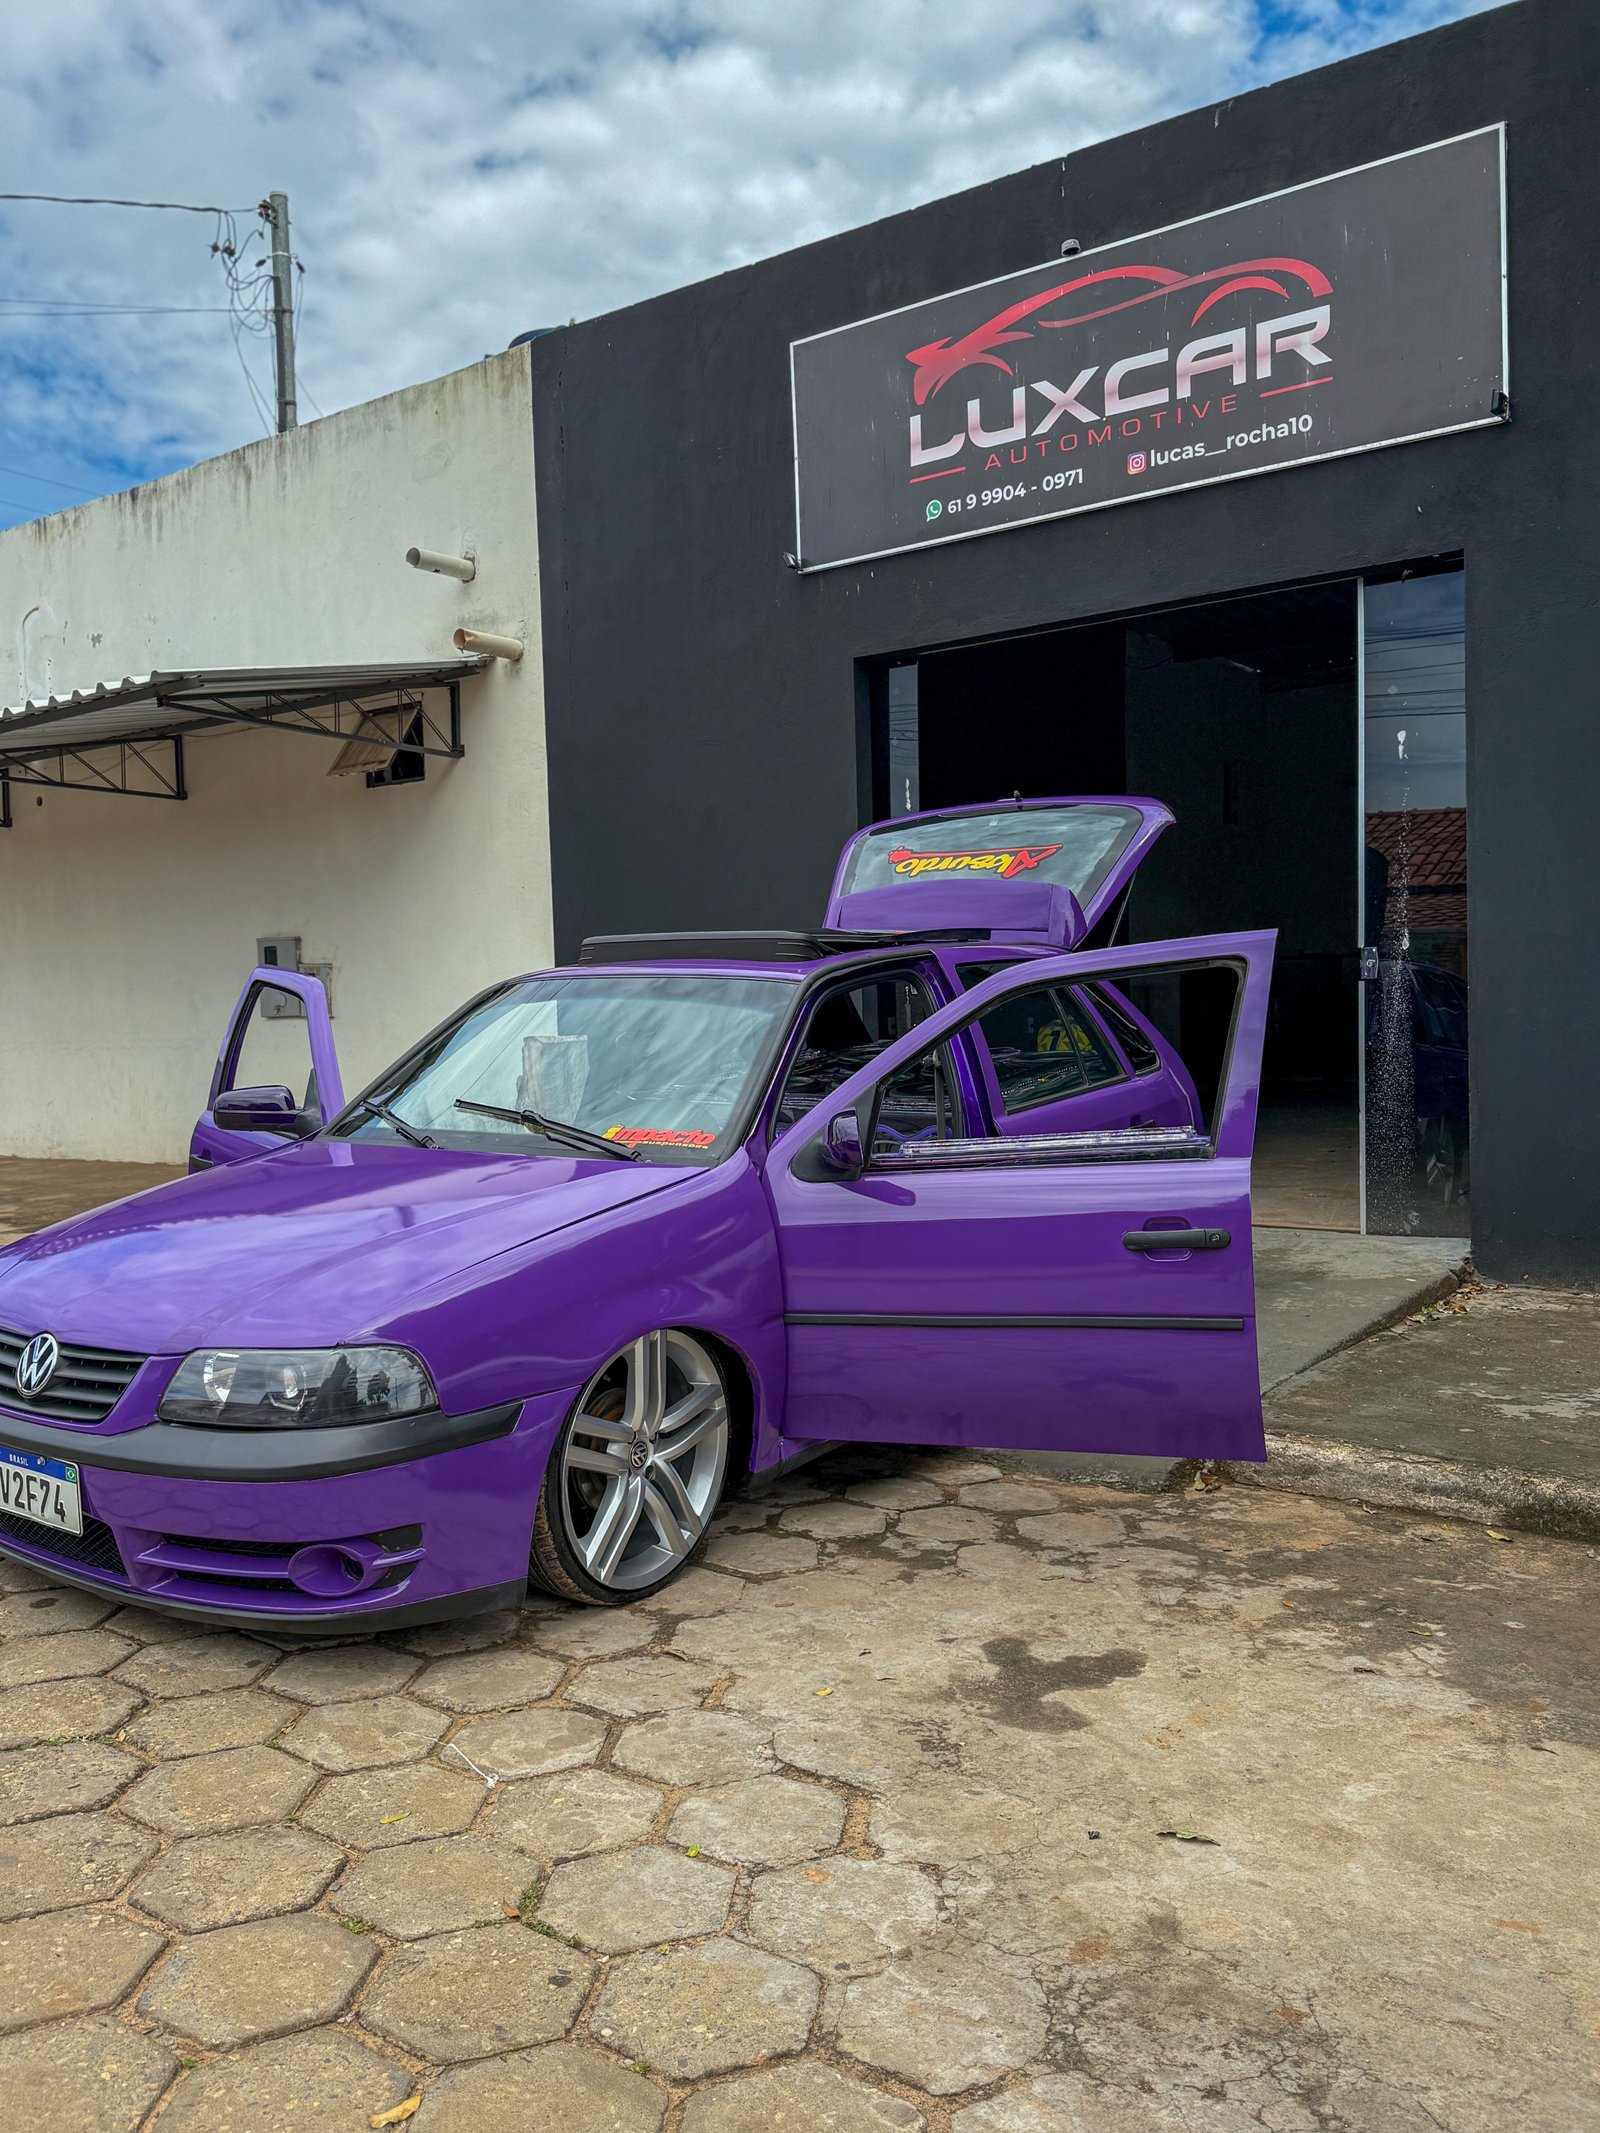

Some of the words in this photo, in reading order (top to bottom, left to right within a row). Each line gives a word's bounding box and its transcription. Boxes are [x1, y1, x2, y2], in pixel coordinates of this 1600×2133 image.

[910, 304, 1333, 467] LUXCAR
[985, 394, 1238, 470] AUTOMOTIVE
[948, 498, 963, 514] 61
[966, 494, 977, 510] 9
[981, 482, 1027, 506] 9904
[1042, 468, 1084, 492] 0971
[9, 1453, 29, 1466] BRASIL
